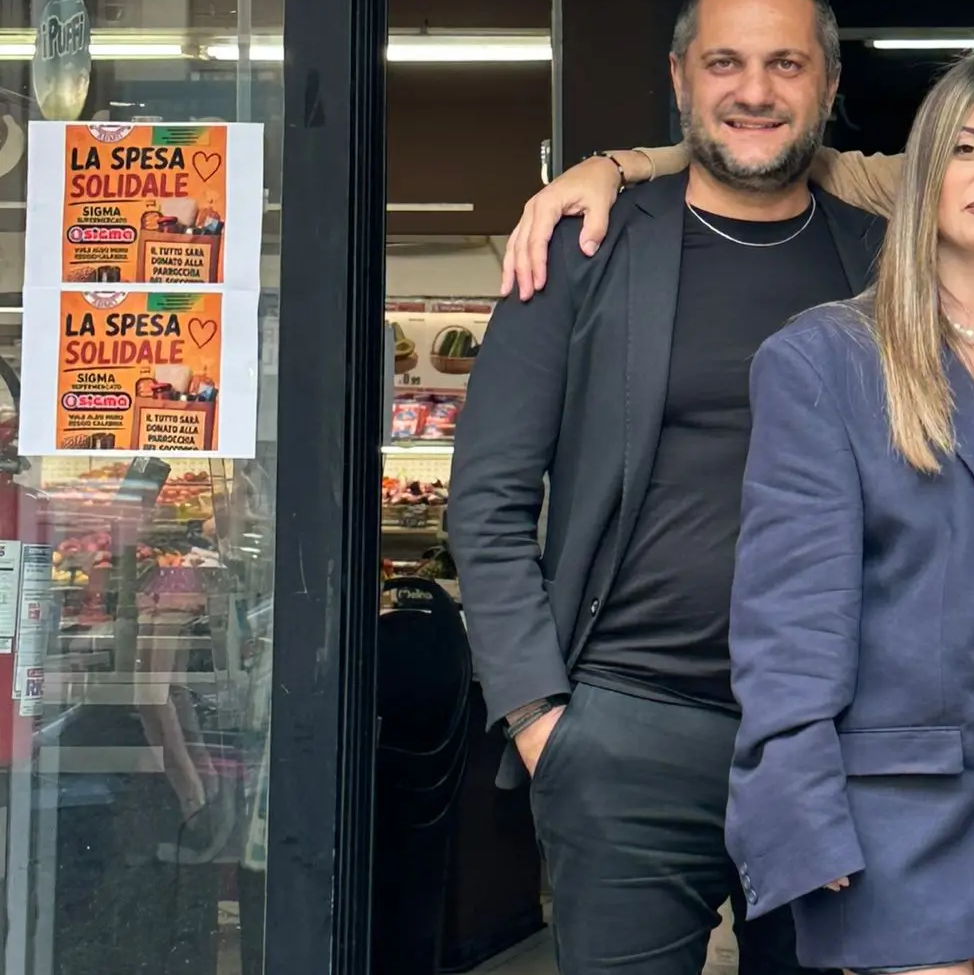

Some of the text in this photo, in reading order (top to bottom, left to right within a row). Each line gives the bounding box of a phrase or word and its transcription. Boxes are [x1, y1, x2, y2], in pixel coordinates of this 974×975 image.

[71, 146, 185, 171] LA SPESA
[70, 173, 189, 198] SOLIDALE
[83, 206, 121, 217] SIGMA
[160, 247, 182, 255] TUTTO
[151, 257, 204, 267] DONATO ALLA
[65, 313, 181, 337] LA SPESA
[65, 340, 185, 365] SOLIDALE
[77, 373, 116, 383] SIGMA
[155, 414, 178, 423] TUTTO
[146, 424, 199, 435] DONATO ALLA
